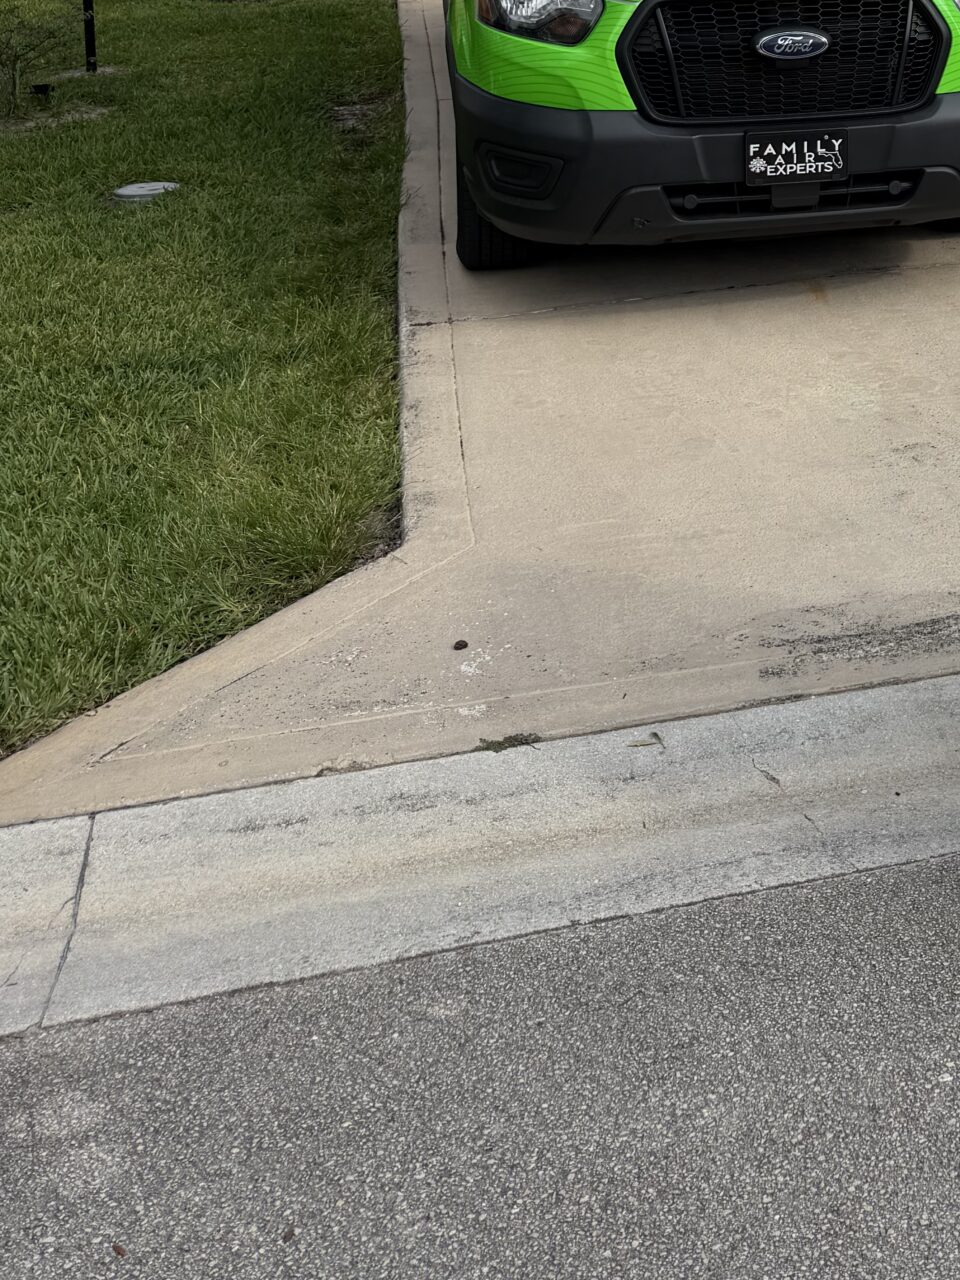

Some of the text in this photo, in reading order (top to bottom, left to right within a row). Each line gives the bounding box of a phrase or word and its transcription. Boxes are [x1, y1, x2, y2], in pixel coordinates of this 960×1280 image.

[774, 36, 814, 54] Ford
[749, 138, 843, 157] FAMILY
[774, 152, 816, 165] AIR
[766, 161, 834, 176] EXPERTS
